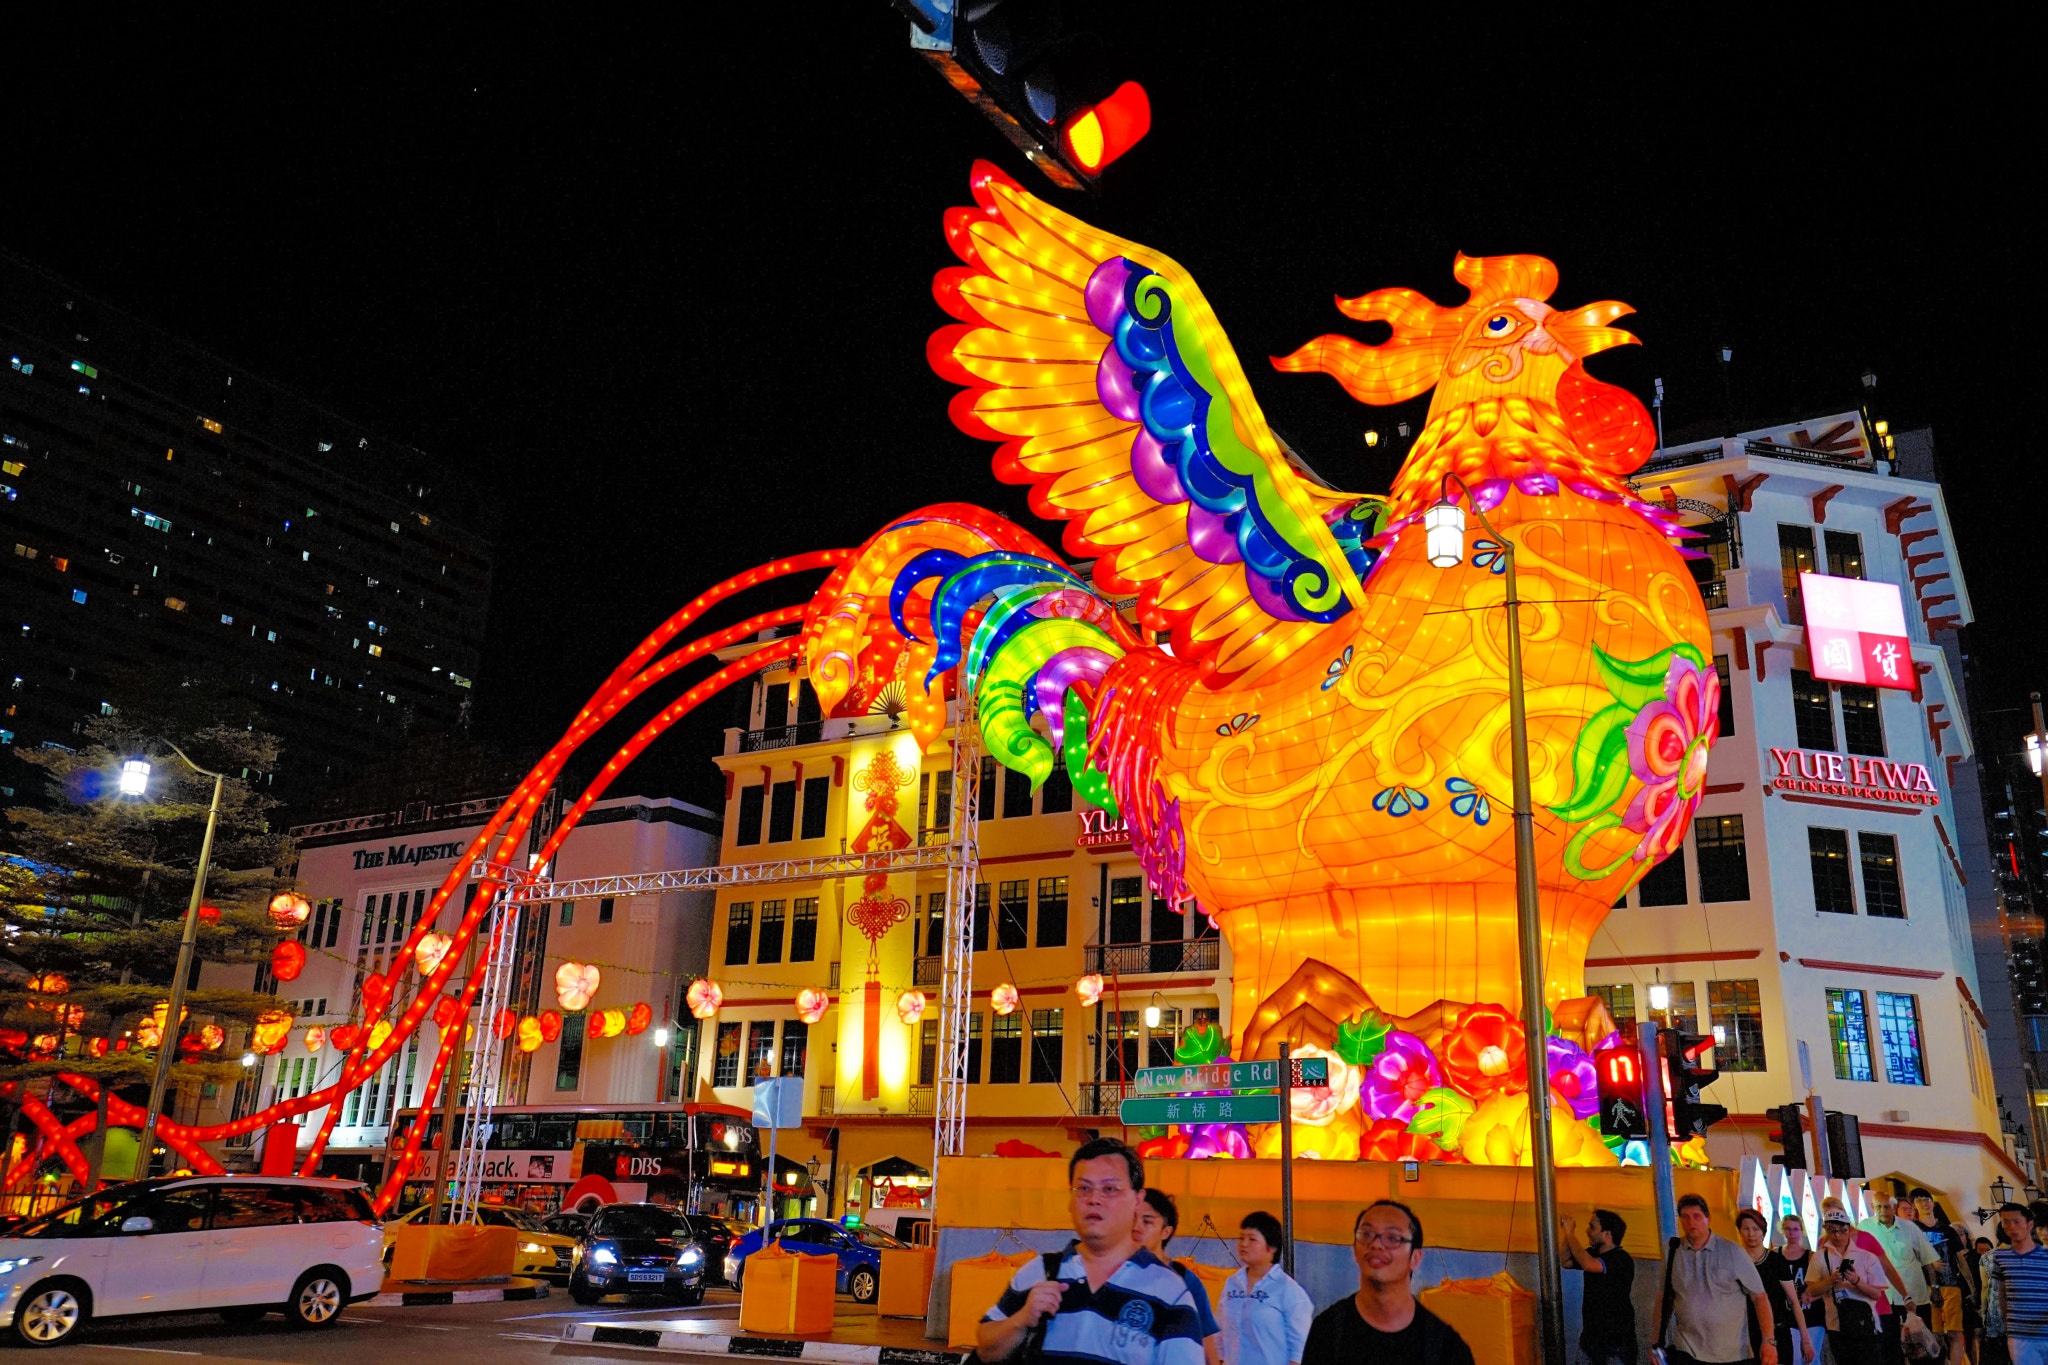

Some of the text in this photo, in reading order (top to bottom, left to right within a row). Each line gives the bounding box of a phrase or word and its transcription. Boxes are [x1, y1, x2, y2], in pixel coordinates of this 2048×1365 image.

[1771, 747, 1937, 792] YUE HWA
[1774, 777, 1940, 806] CHINESE PRODUCTS
[1077, 832, 1129, 846] CHINES
[353, 841, 466, 870] THE MAJESTIC
[1143, 1063, 1272, 1087] New Bridge Rd
[1610, 1056, 1633, 1083] 17
[1167, 1102, 1233, 1119] 新桥路
[630, 1157, 662, 1176] DBS
